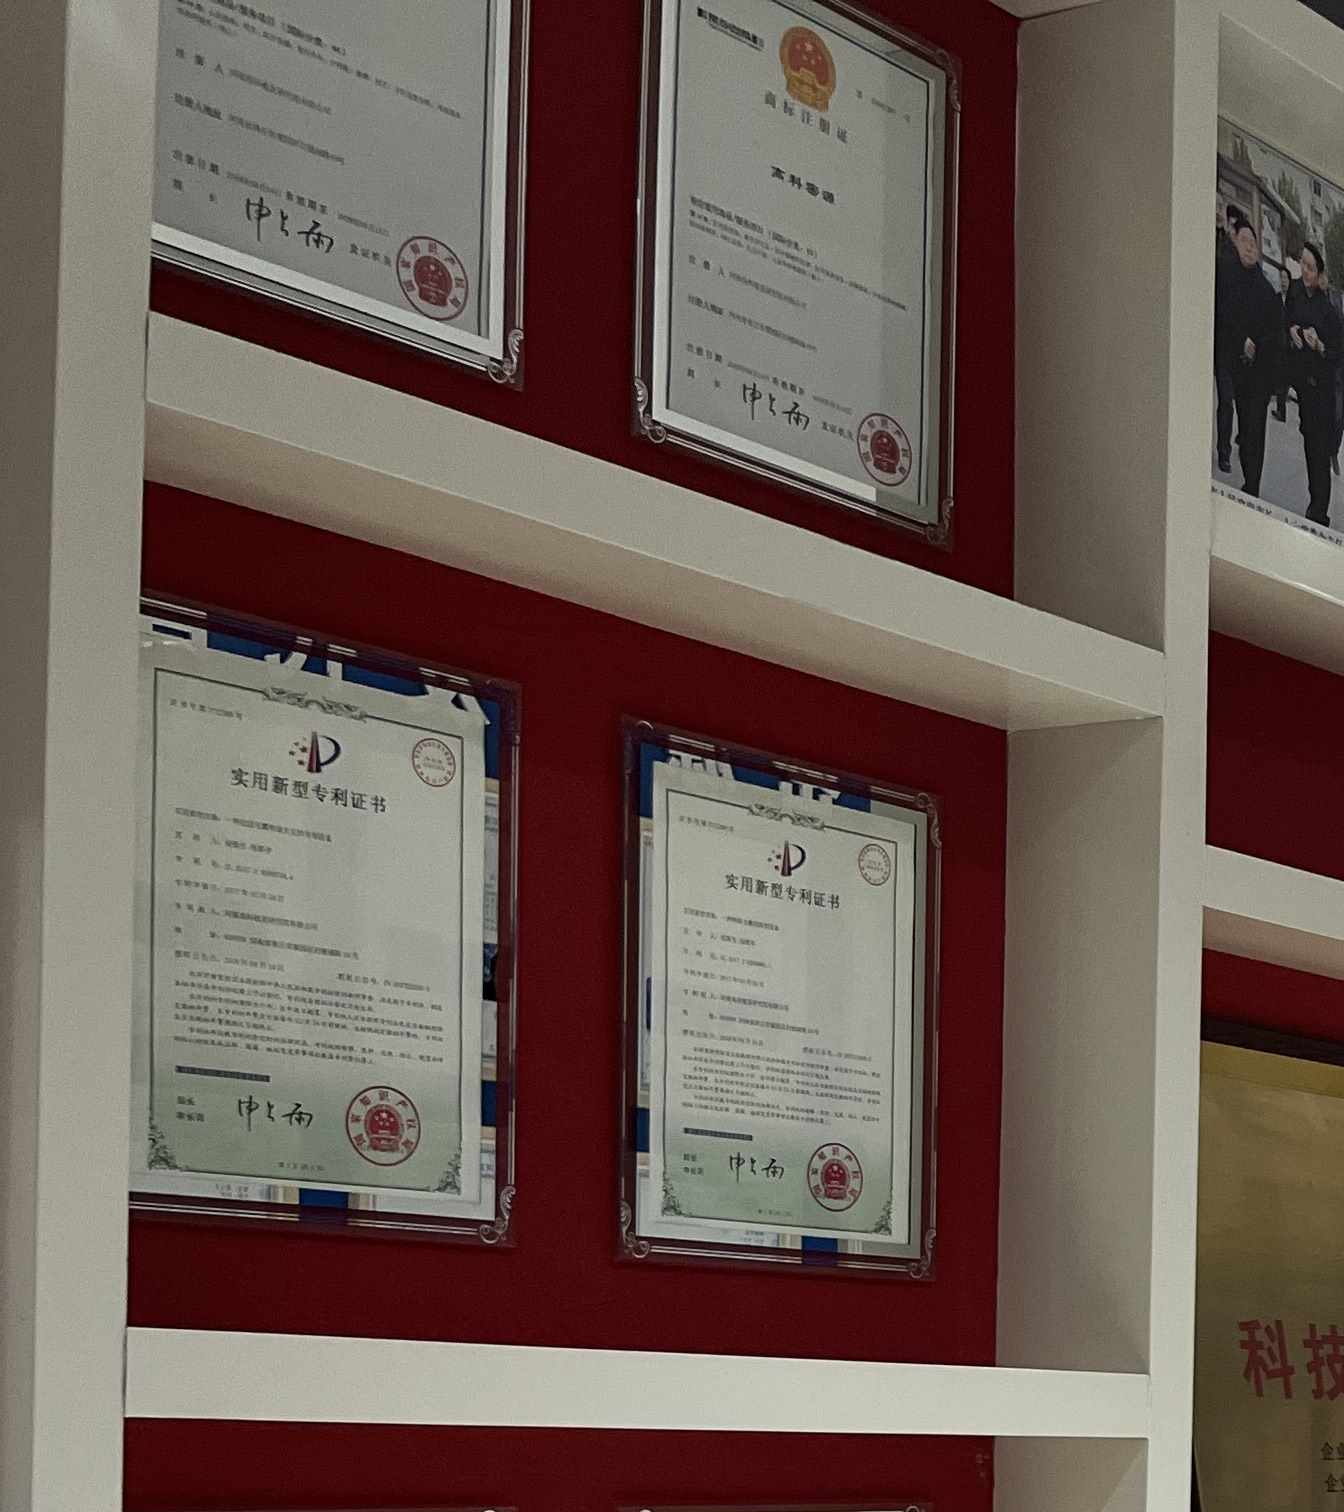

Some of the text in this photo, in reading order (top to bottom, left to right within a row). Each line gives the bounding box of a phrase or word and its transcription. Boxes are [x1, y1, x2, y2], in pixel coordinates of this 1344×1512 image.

[231, 768, 387, 813] 实用新型专利证书
[725, 873, 840, 910] 实用新型专利证书
